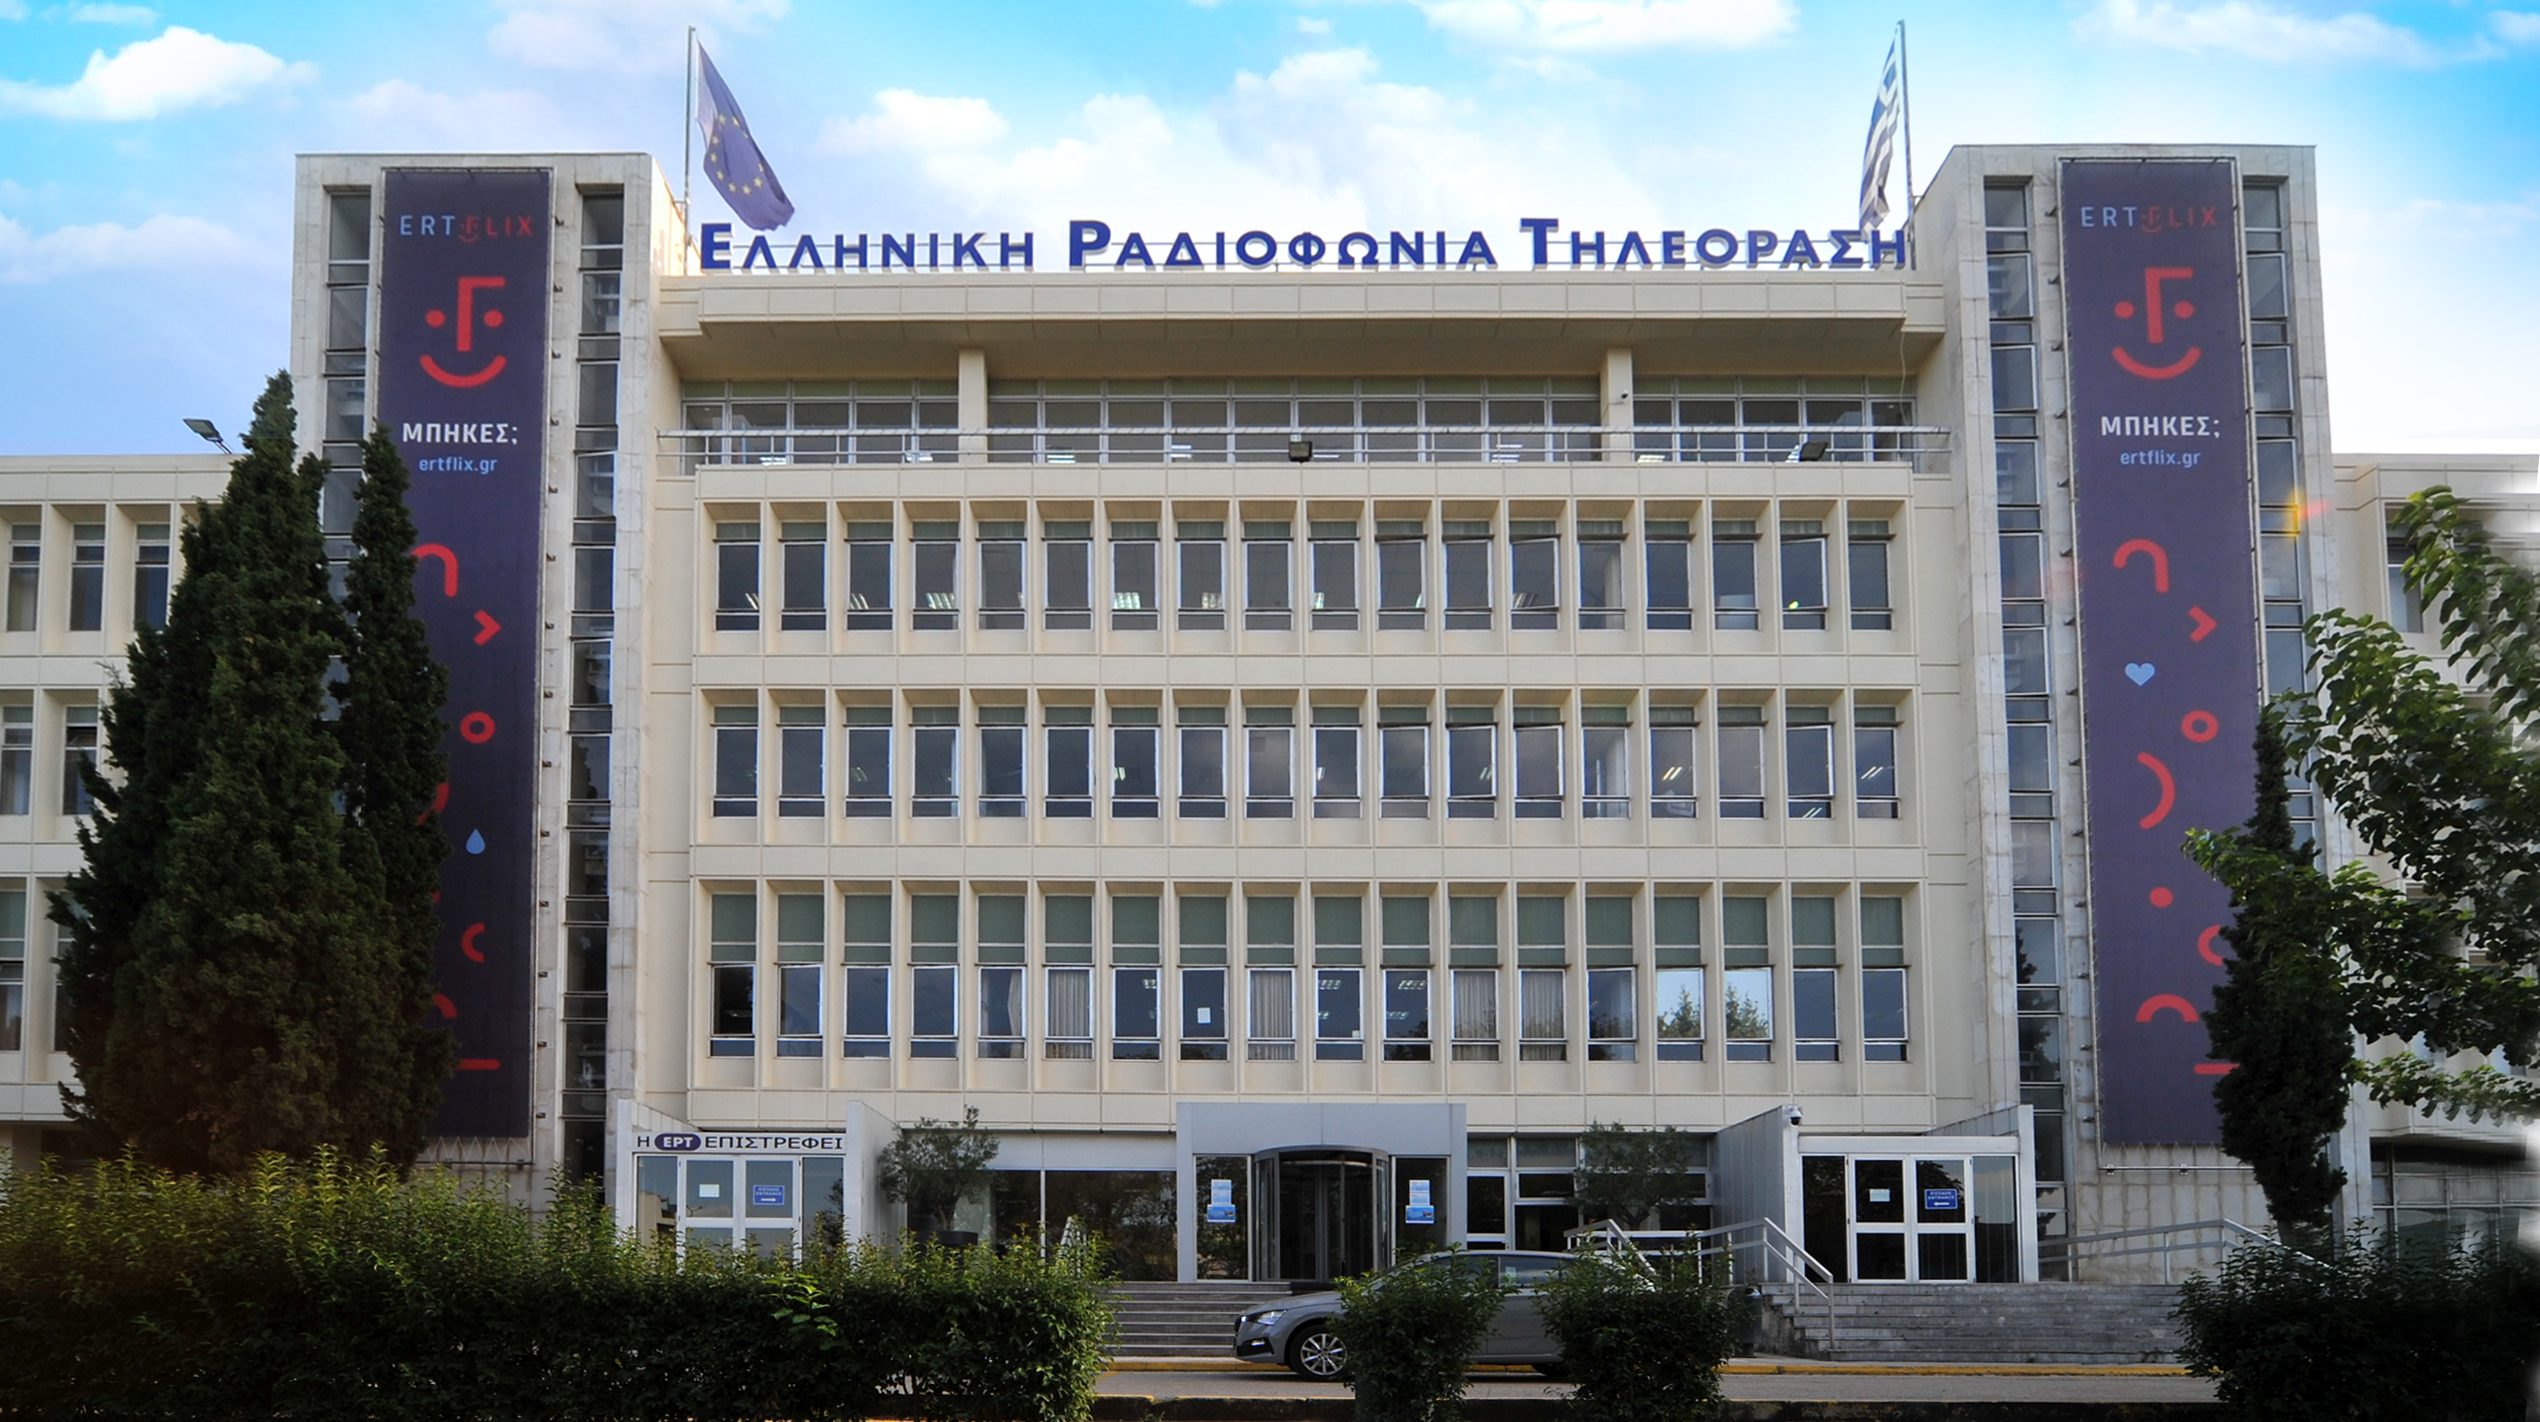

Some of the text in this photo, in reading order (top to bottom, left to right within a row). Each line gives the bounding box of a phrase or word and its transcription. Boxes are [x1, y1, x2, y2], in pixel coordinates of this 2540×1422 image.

[399, 215, 533, 238] ERTFLIX
[2080, 206, 2217, 229] ERTFLIX
[700, 218, 1906, 271] ΕΛΛΗΝΙΚΗ ΡΑΔΙΟΦΩΝΙΑ ΤΗΛΕΟΡΑΣΗ
[402, 423, 519, 445] ΜΠΗΚΕΣ;
[2101, 416, 2221, 439] ΜΠΗΚΕΣ;
[418, 456, 498, 475] ertflix.gr
[2120, 449, 2201, 468] ertflix.gr
[637, 1136, 843, 1149] Η ΕΡΤ ΕΠΙΣΤΡΕΦΕΙ
